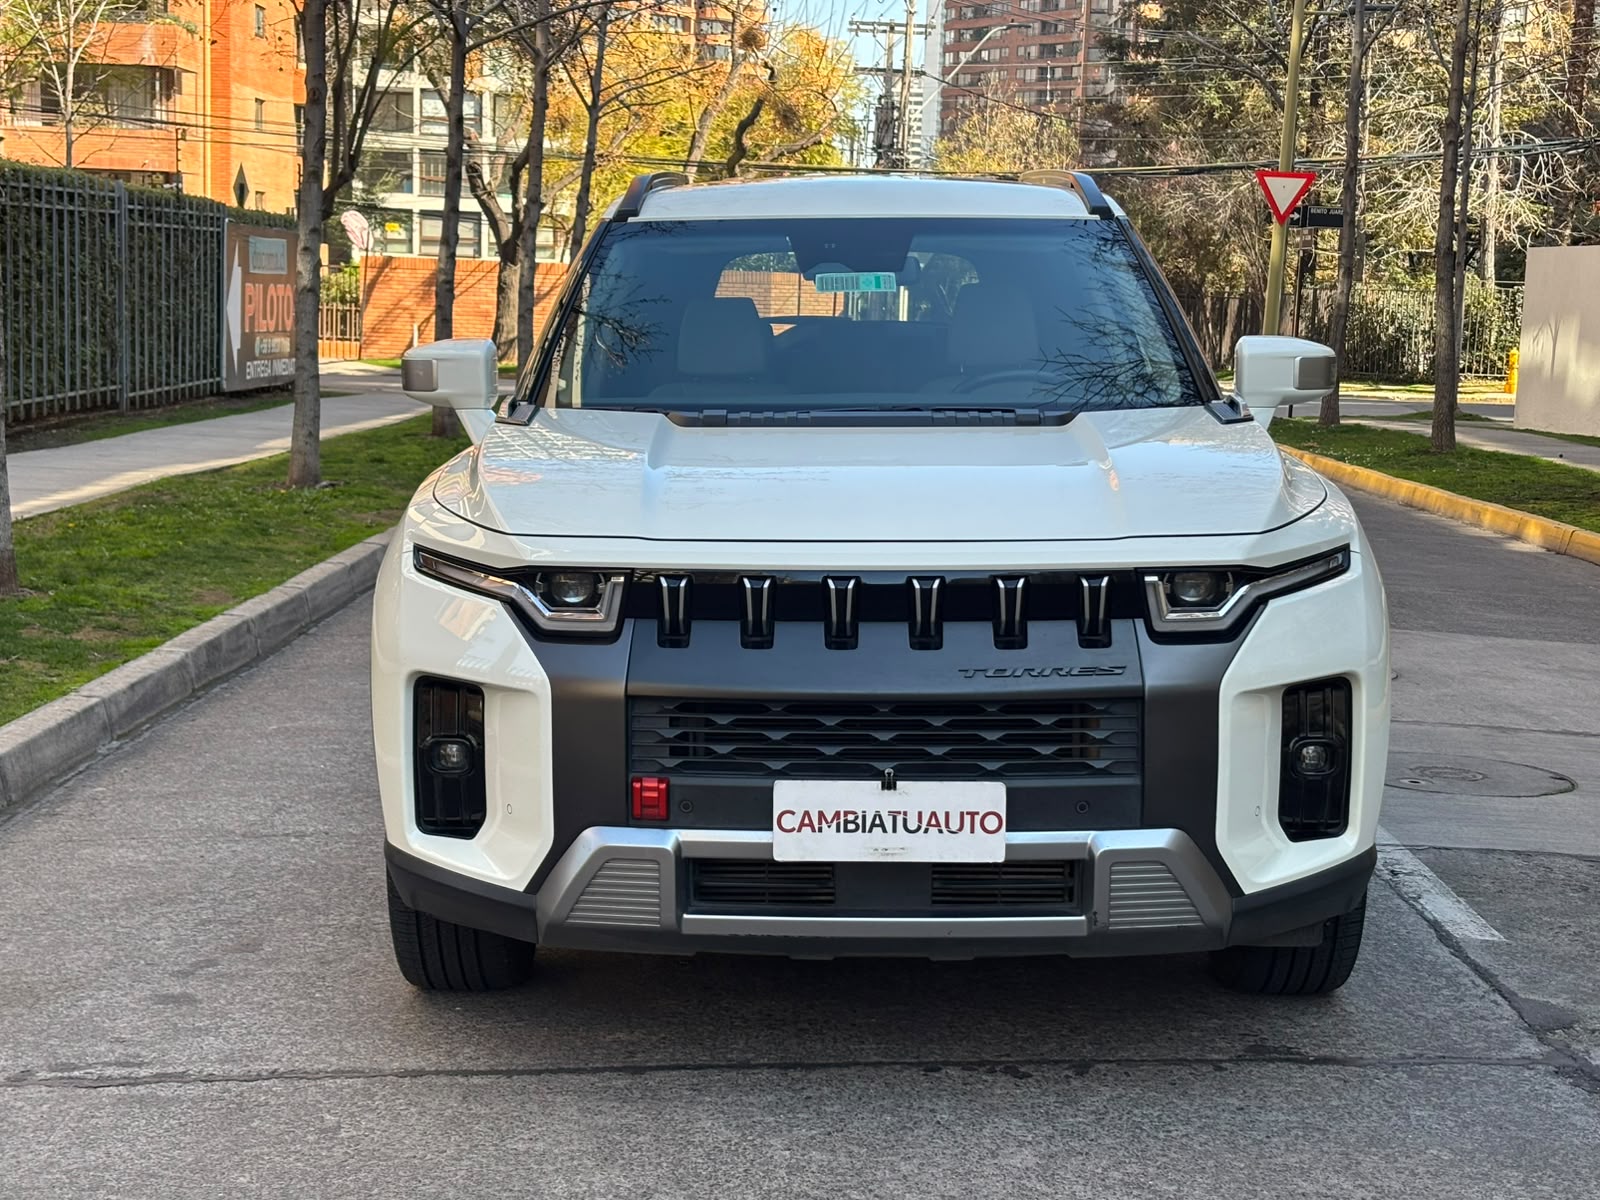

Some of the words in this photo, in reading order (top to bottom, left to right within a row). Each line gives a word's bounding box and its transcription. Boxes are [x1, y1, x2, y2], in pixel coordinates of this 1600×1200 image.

[1310, 207, 1328, 215] BENITO
[1329, 208, 1344, 216] JUARE
[244, 282, 297, 333] PILOTO
[245, 359, 272, 380] ENTREGA
[272, 357, 296, 377] INMEDIAT
[958, 665, 1127, 679] TORRES
[776, 809, 1004, 835] CAMBIATUAUTO
